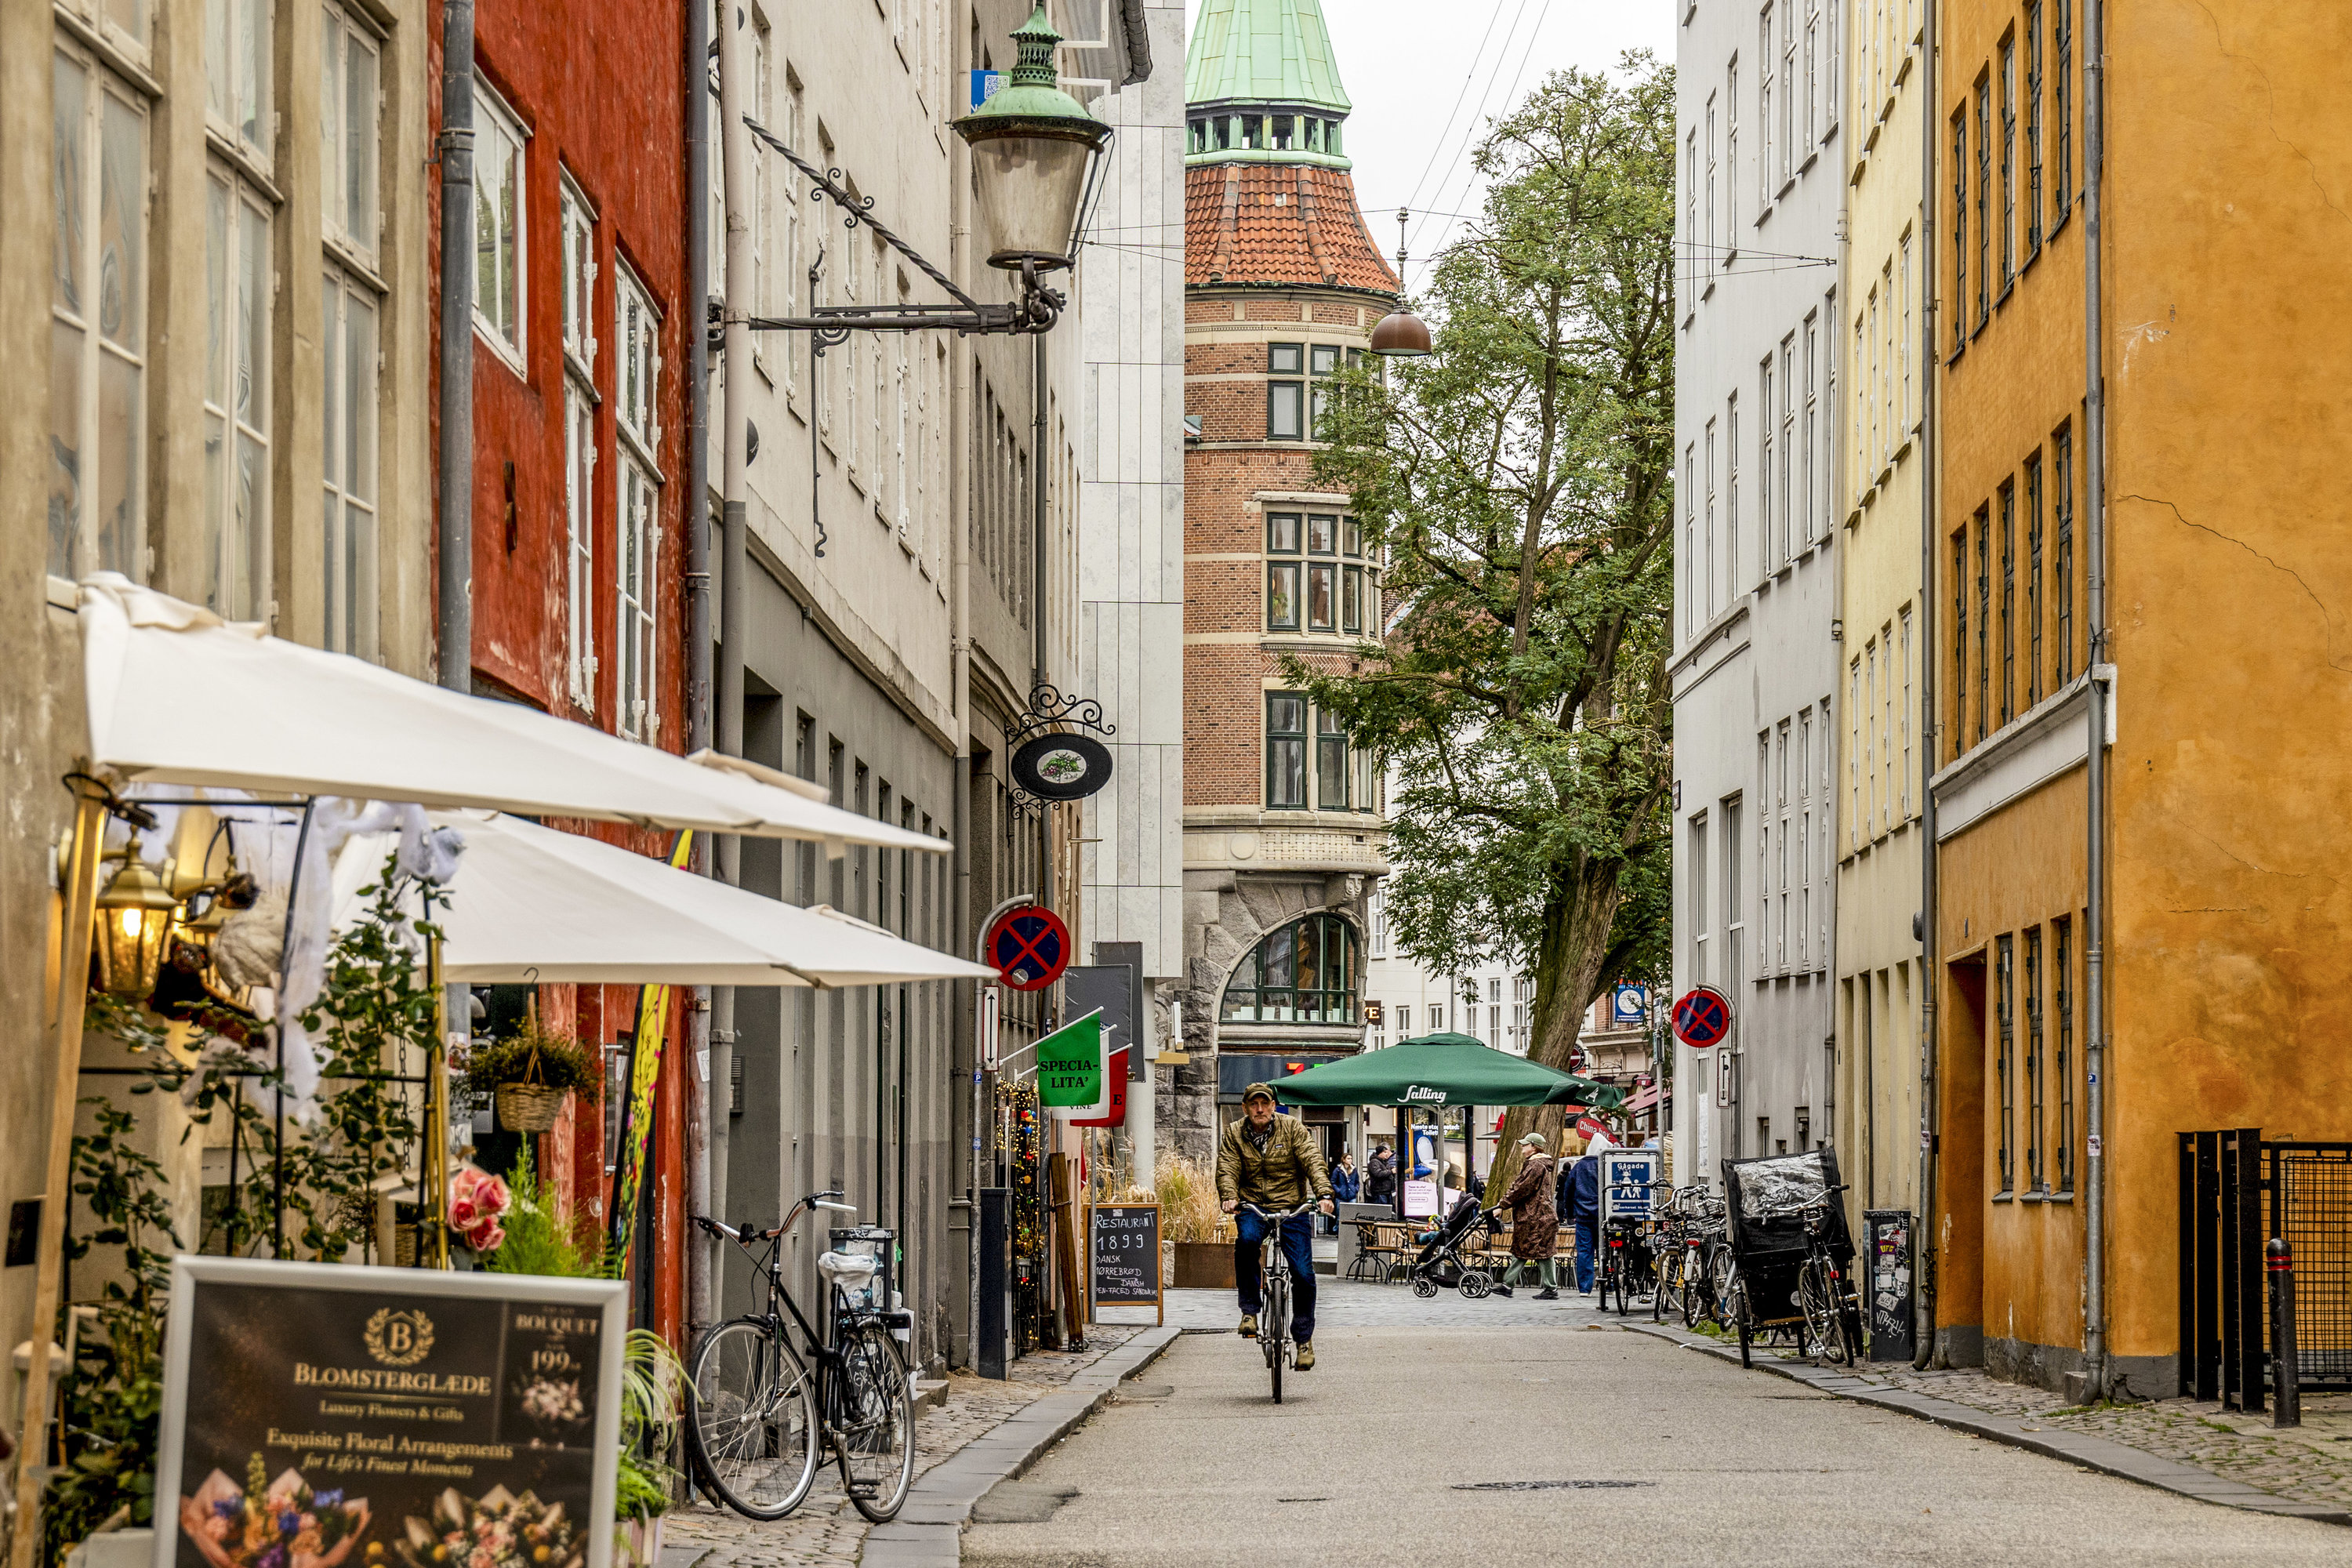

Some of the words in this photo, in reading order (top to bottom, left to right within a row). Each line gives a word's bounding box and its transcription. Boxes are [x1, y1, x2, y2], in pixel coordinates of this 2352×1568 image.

[1040, 1060, 1099, 1072] SPECIA-
[1397, 1084, 1446, 1103] Salling
[1580, 1120, 1597, 1134] China
[1096, 1211, 1156, 1229] RESTAURANT
[1096, 1287, 1130, 1295] PEN-FACED
[515, 1313, 599, 1336] BOUQUET
[532, 1350, 571, 1372] 199
[294, 1361, 492, 1396] BLOMSTERGLÆDE
[319, 1399, 365, 1420] Luxury
[368, 1402, 416, 1420] Flowers
[417, 1406, 430, 1421] &
[432, 1406, 465, 1423] Gifts
[266, 1428, 343, 1450] Exquisite
[345, 1431, 394, 1451] Floral
[397, 1436, 514, 1461] Arrangements
[301, 1452, 325, 1472] for
[365, 1456, 408, 1474] Finest
[410, 1458, 474, 1479] Moments
